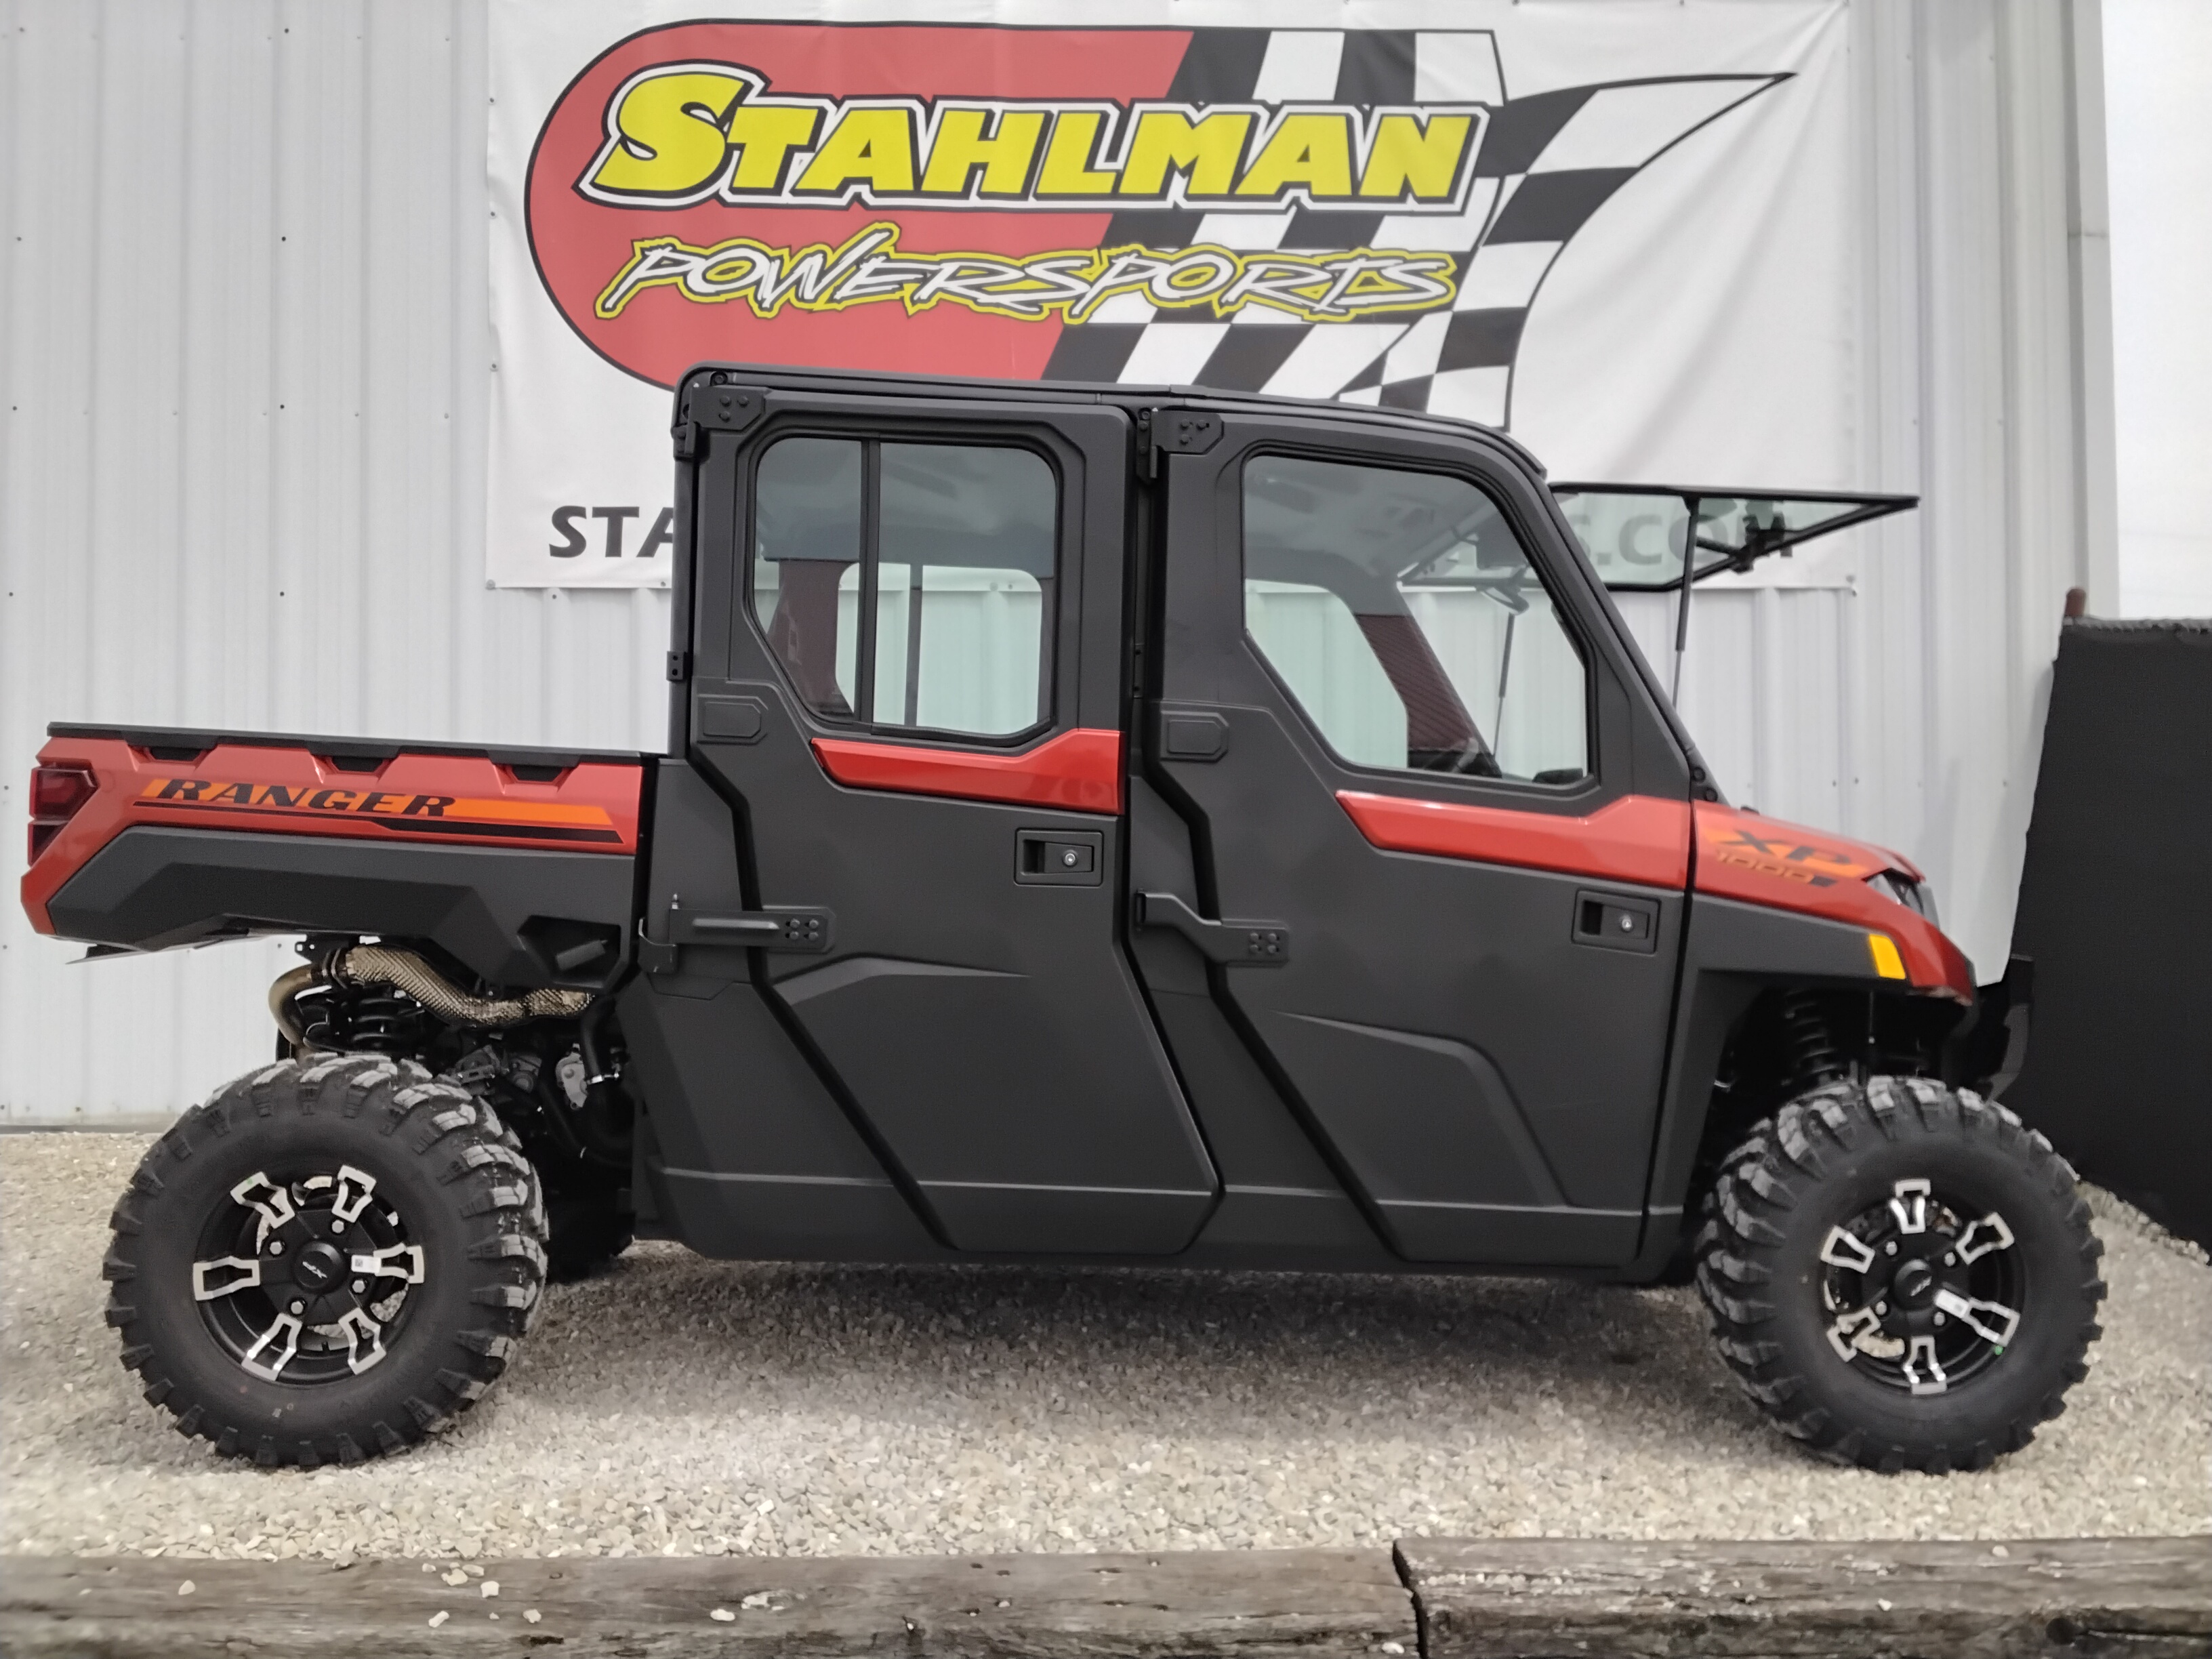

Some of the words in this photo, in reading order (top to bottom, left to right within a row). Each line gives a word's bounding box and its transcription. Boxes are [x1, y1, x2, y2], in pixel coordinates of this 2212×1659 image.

[577, 62, 1487, 212] STAHLMAN
[596, 223, 1455, 323] POWERSPORTS
[157, 778, 456, 817] RANGER
[1718, 828, 1851, 865] XP
